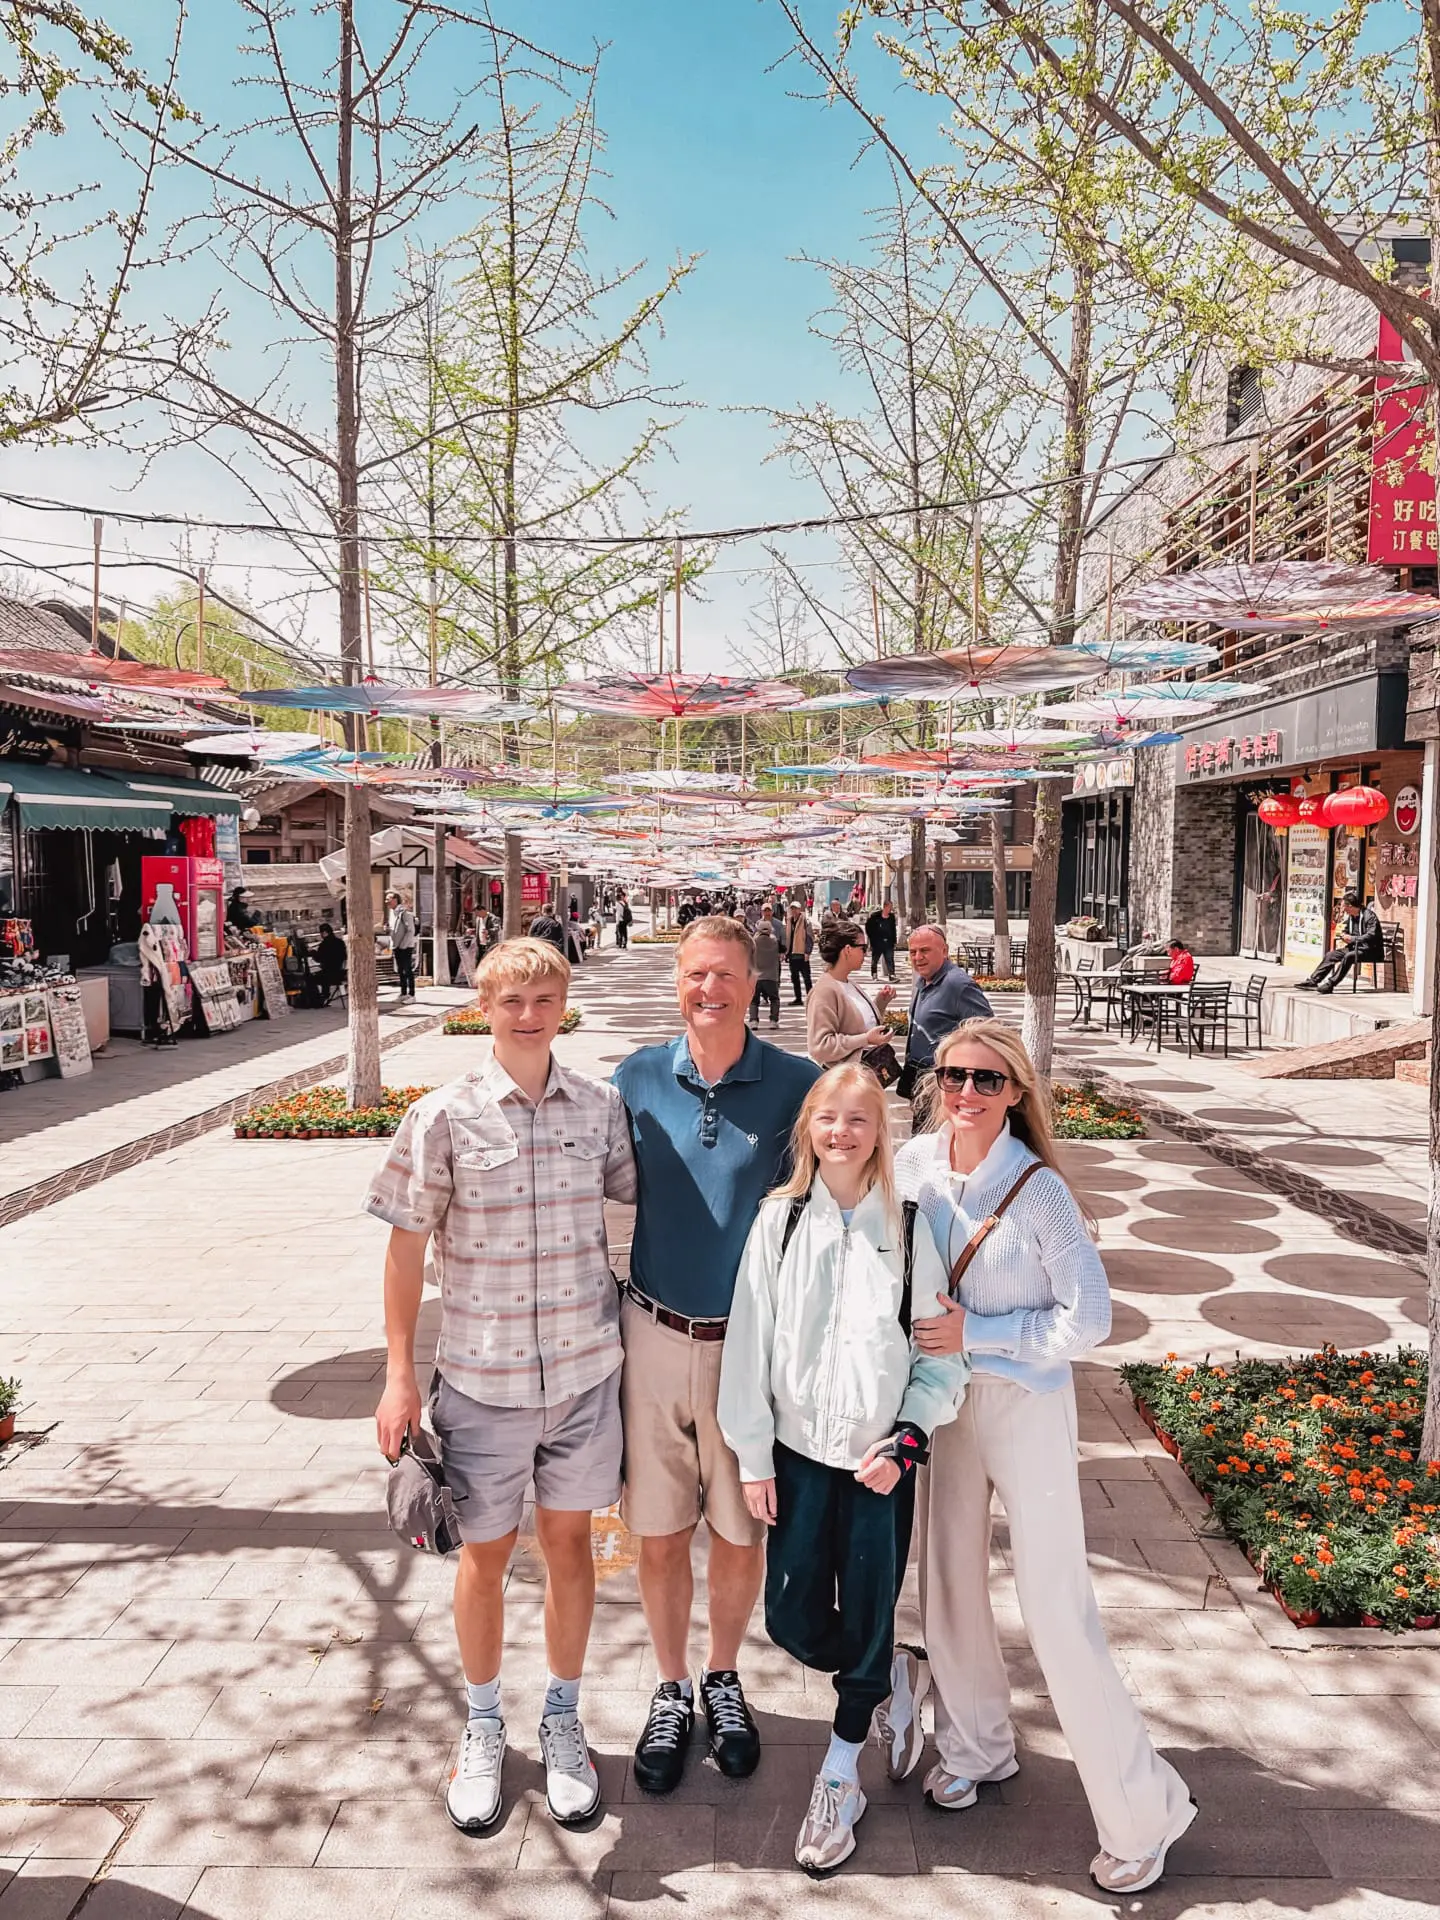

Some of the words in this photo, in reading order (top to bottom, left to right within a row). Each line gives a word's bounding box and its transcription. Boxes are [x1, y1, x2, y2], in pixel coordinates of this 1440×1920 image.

[1393, 500, 1436, 522] 好吃
[1392, 530, 1438, 551] 订餐电
